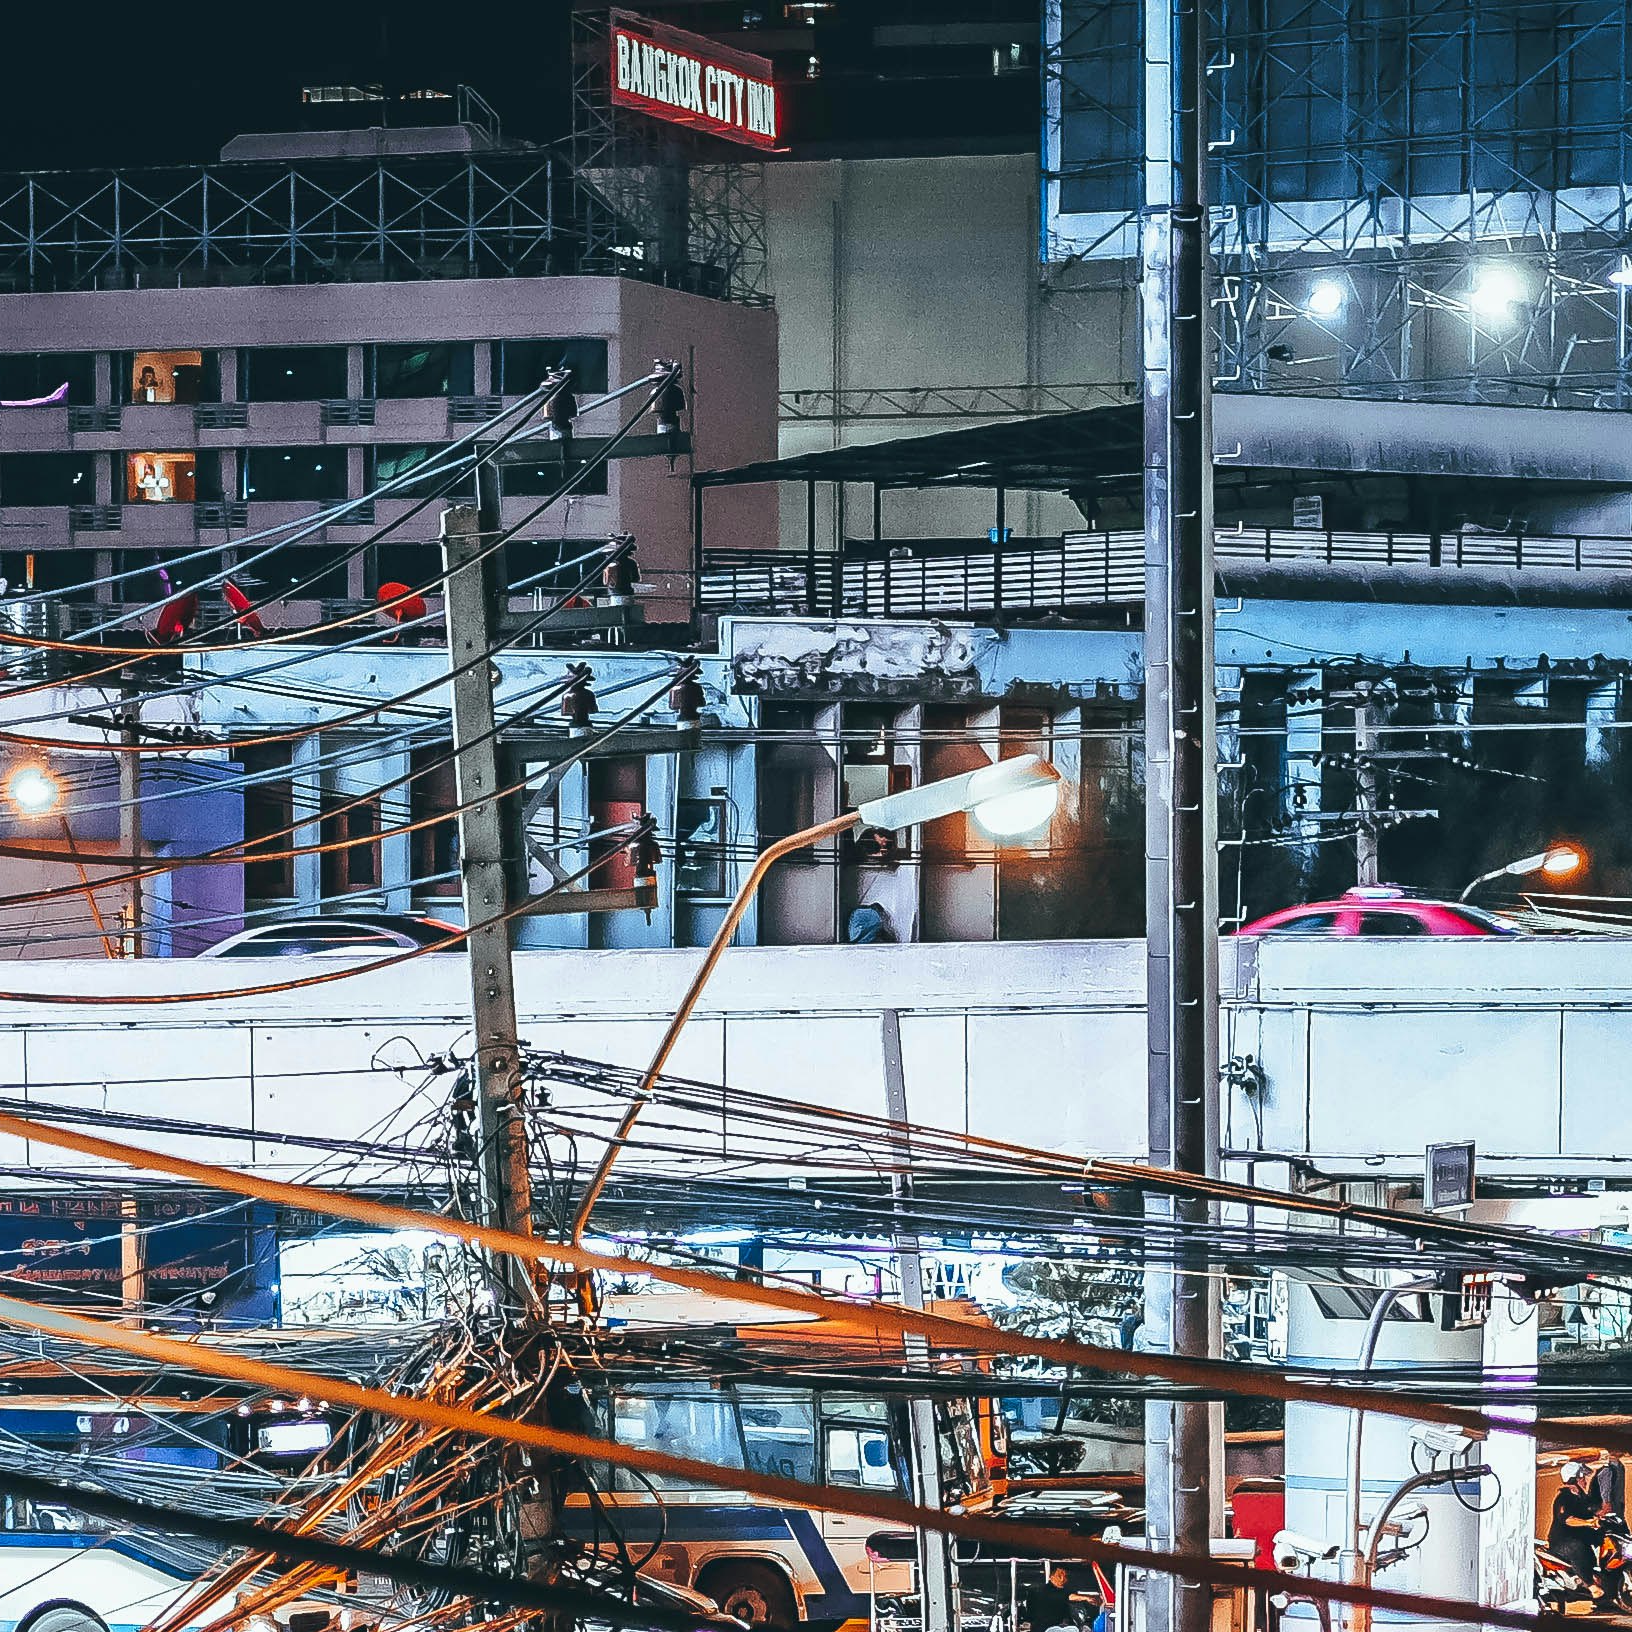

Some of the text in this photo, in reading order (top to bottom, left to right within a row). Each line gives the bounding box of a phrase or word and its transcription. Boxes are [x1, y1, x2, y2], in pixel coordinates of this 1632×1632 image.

[616, 34, 776, 138] BANGKOK CITY INN
